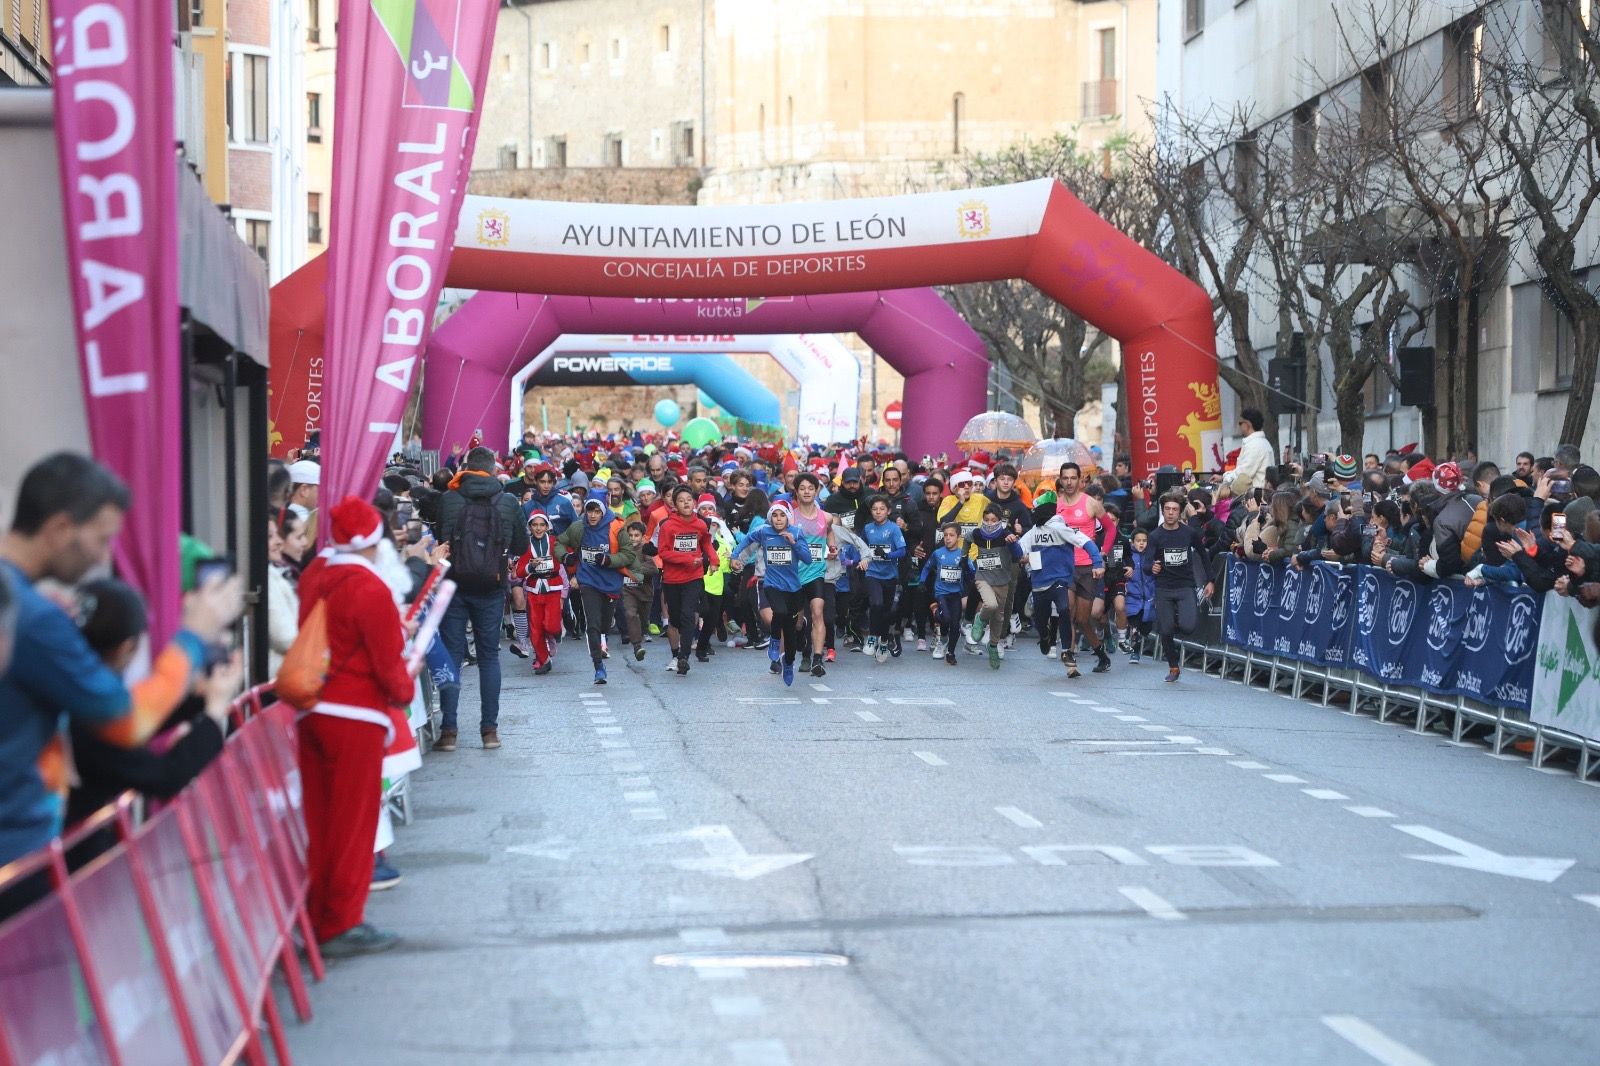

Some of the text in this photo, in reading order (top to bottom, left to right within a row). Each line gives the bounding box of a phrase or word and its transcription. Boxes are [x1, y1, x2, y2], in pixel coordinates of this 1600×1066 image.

[562, 213, 906, 248] AYUNTAMIENTO DE LEÓN
[603, 255, 866, 280] CONCEJALÍA DE DEPORTES
[697, 305, 742, 318] kutxa
[553, 357, 674, 373] POWERADE
[1140, 351, 1160, 453] DEPORTES
